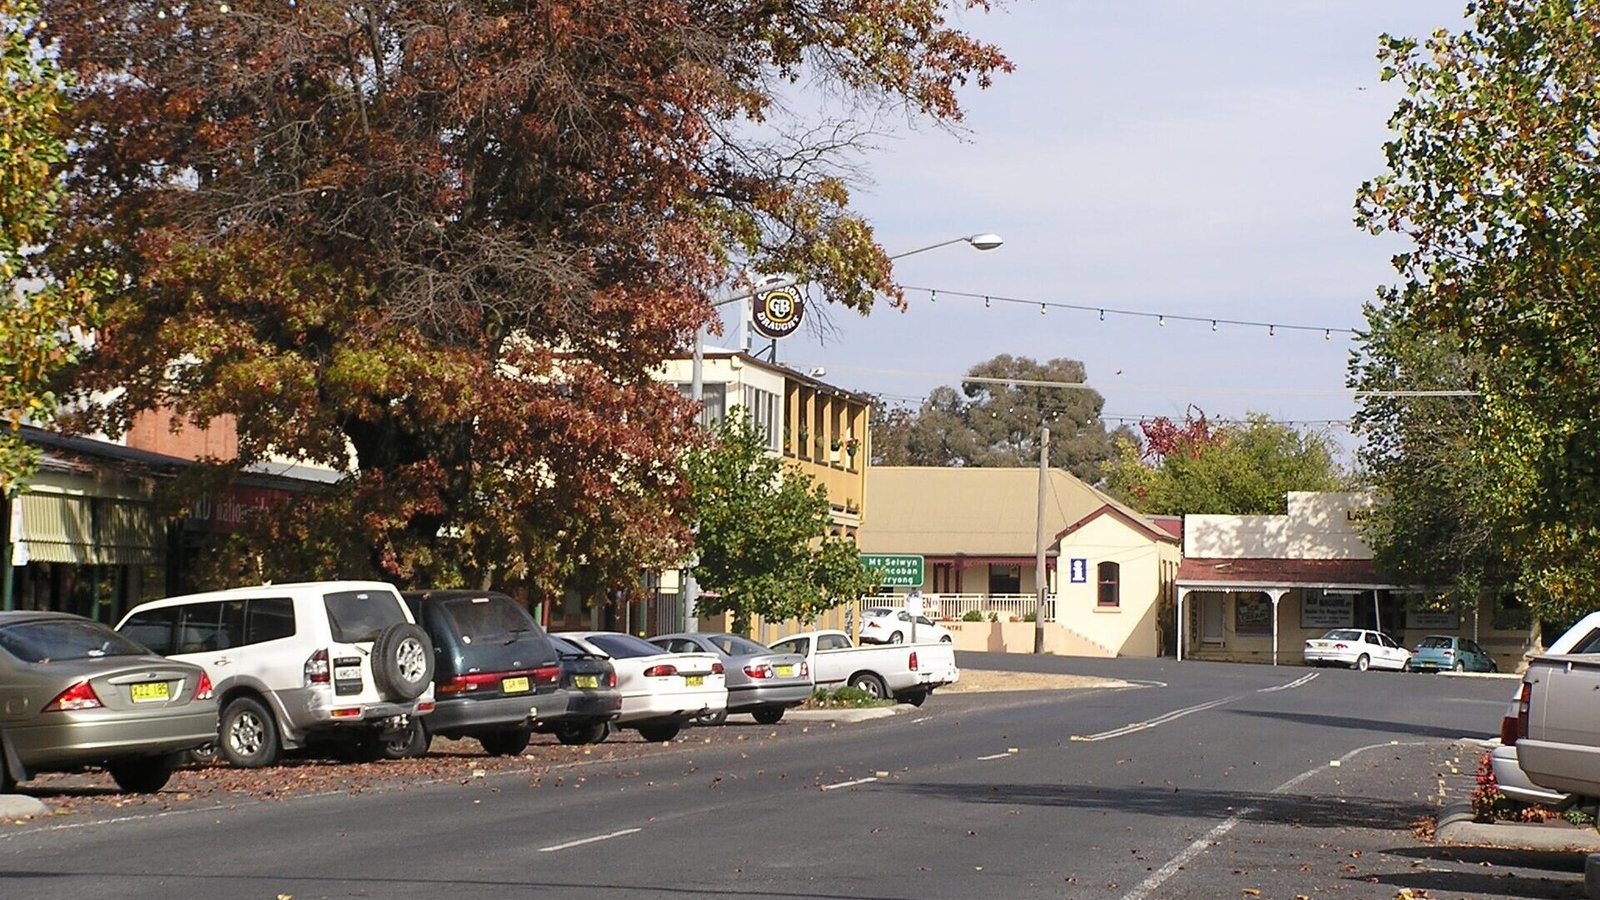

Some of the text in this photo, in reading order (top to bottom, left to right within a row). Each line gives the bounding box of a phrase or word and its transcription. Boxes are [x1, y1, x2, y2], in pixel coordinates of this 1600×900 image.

[757, 311, 800, 331] DRAUGHT
[868, 558, 918, 568] Mt Selwyn
